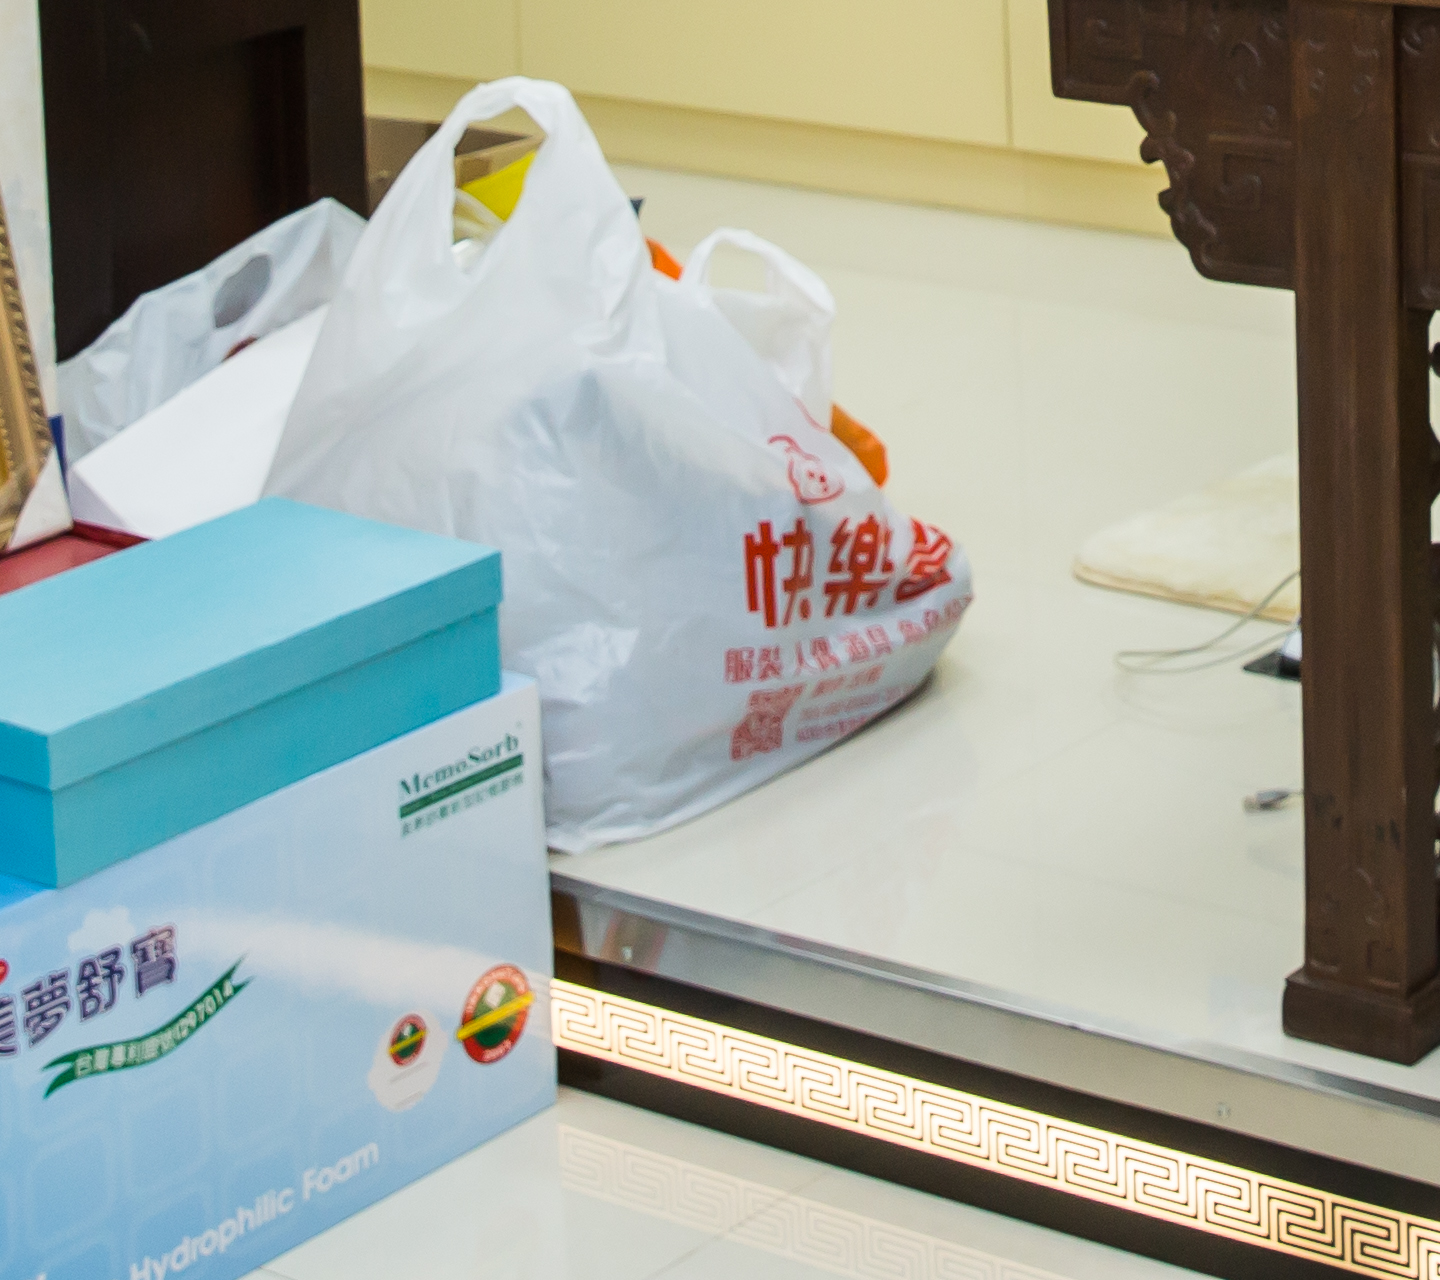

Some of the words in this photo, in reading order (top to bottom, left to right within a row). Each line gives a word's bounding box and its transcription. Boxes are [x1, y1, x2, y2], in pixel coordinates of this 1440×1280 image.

[398, 732, 520, 801] MemoSorb
[129, 1186, 296, 1280] Hydrophilic
[301, 1141, 380, 1201] Foam
